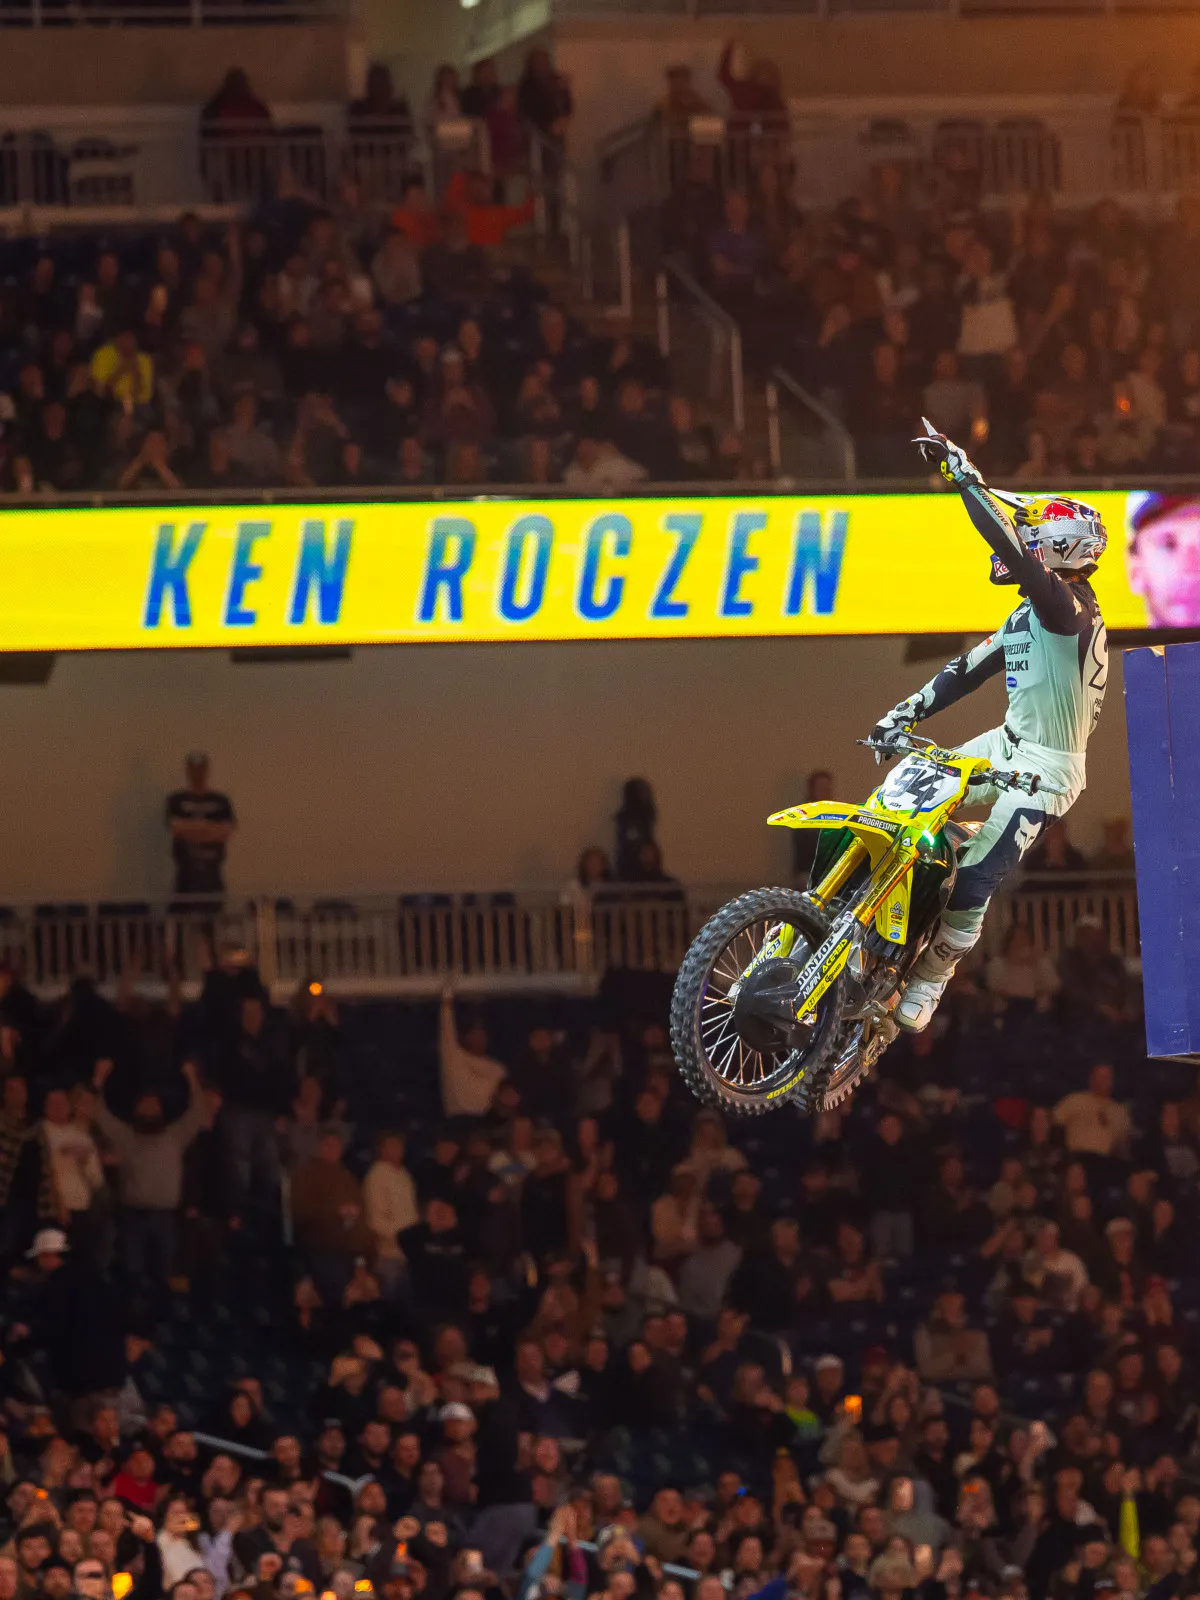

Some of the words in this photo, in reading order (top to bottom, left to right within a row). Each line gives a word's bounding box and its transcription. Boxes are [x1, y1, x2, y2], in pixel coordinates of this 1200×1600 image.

[143, 520, 356, 628] KEN
[418, 510, 852, 623] ROCZEN
[884, 767, 946, 806] 94
[858, 816, 898, 833] PROGRESSIVE
[797, 935, 834, 988] DUNLOP
[766, 1068, 806, 1100] DUNLOP
